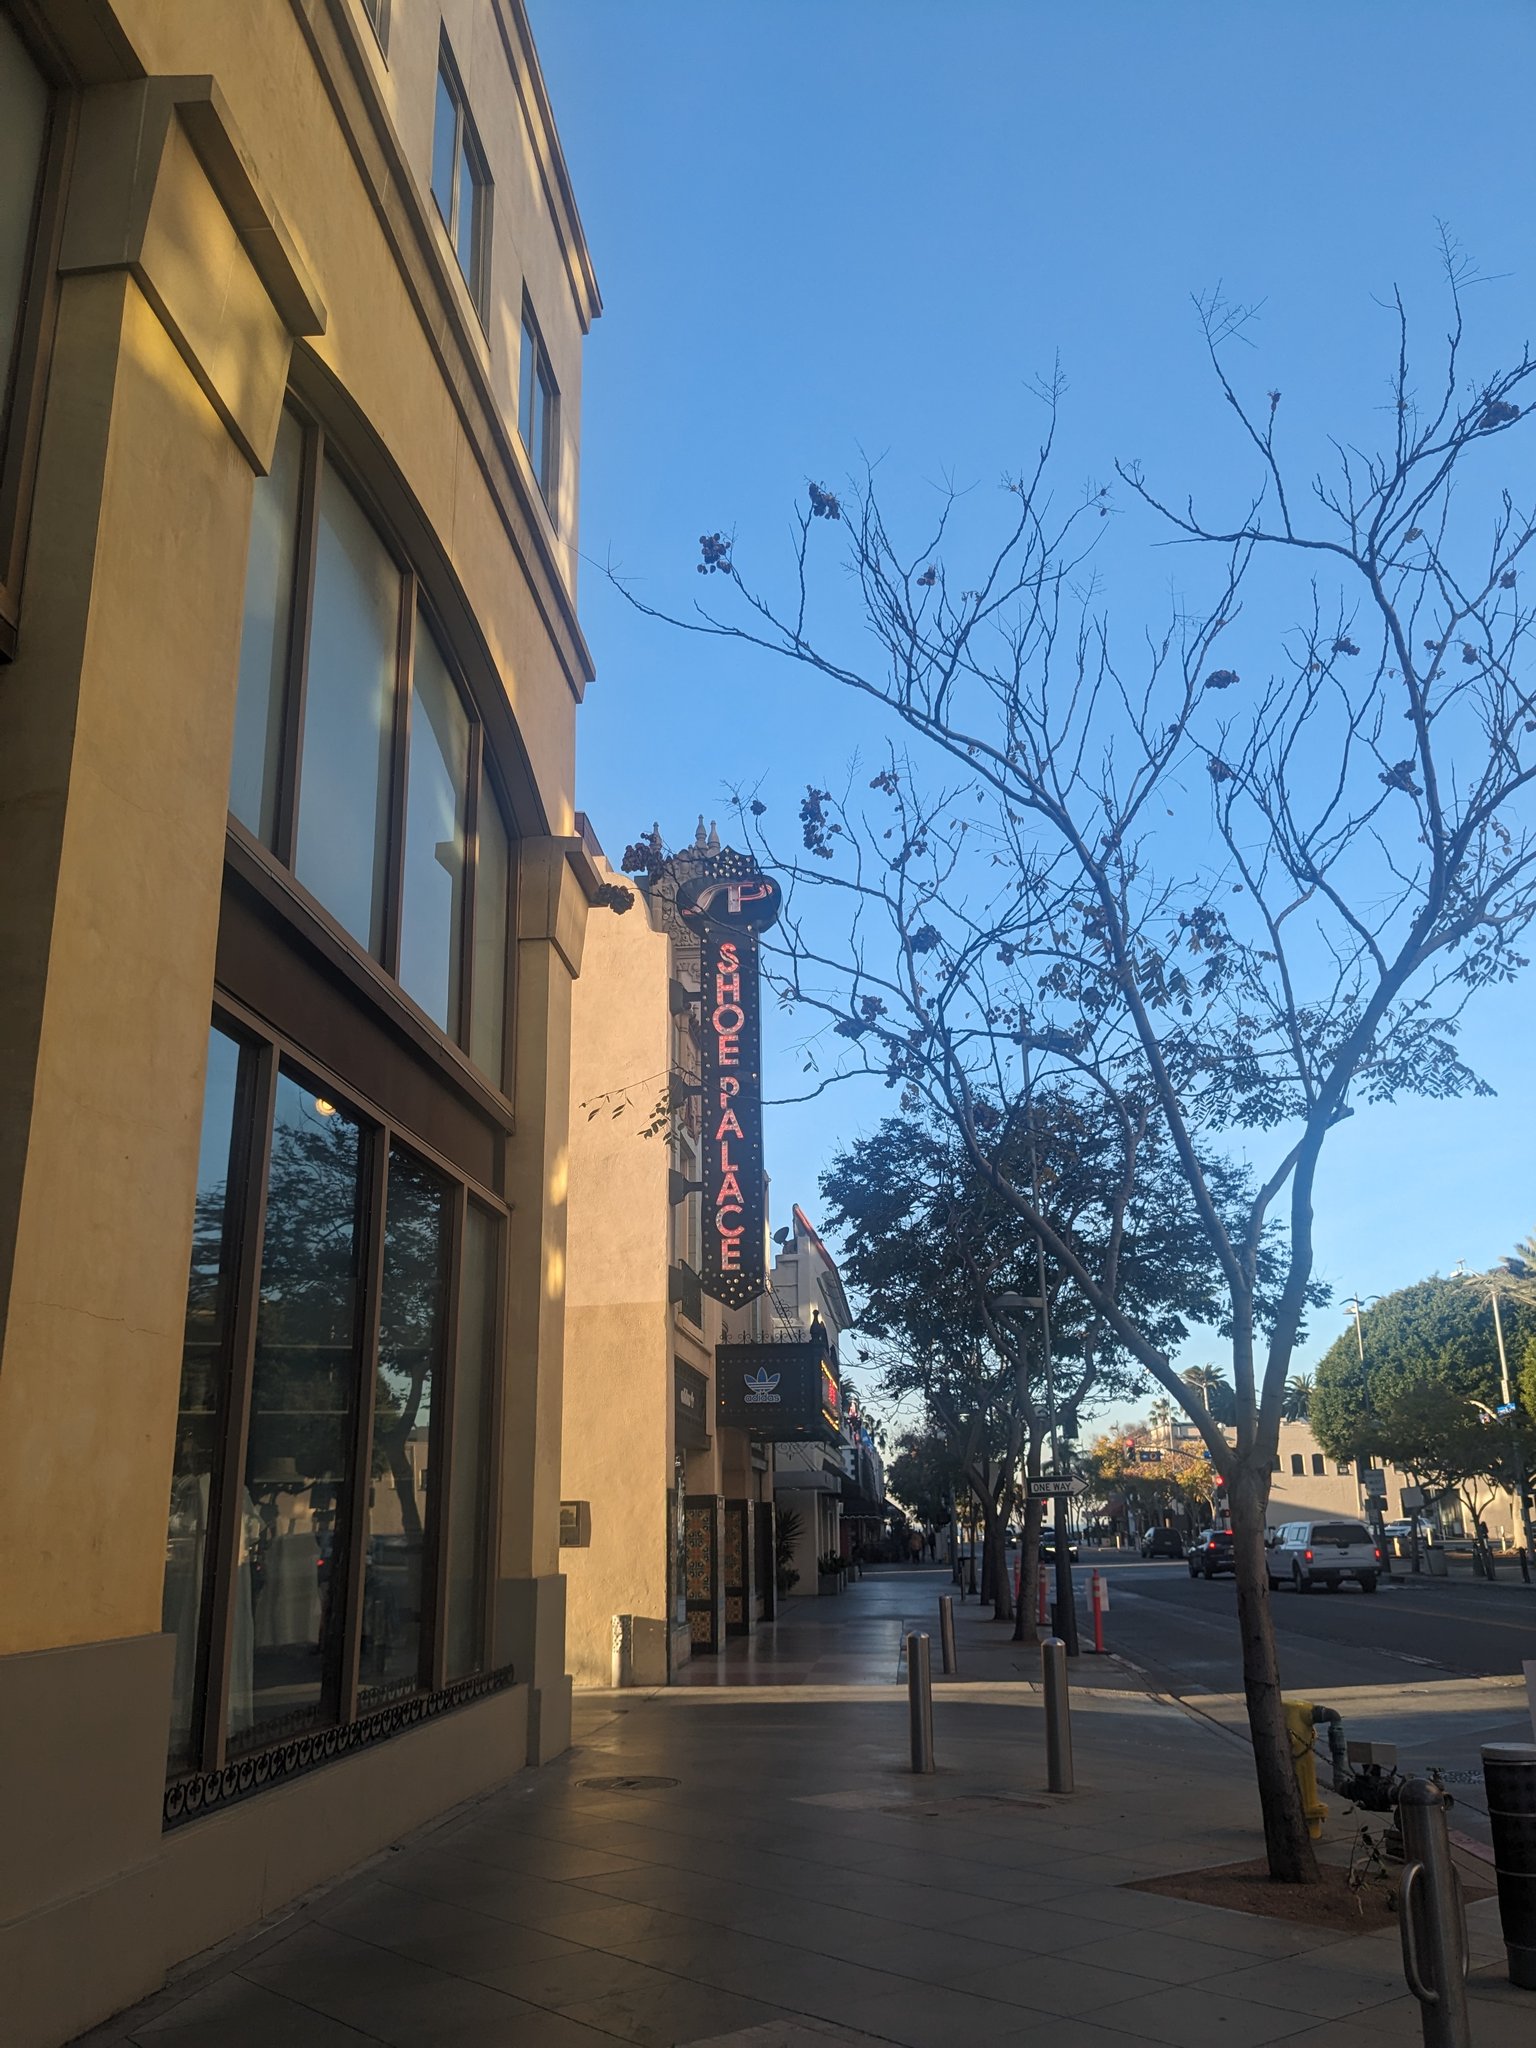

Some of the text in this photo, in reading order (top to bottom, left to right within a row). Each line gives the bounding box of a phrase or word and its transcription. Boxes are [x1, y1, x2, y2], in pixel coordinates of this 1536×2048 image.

[712, 943, 745, 1271] SHOE PALACE
[744, 1391, 781, 1403] adidas
[1033, 1482, 1071, 1492] ONE WAY
